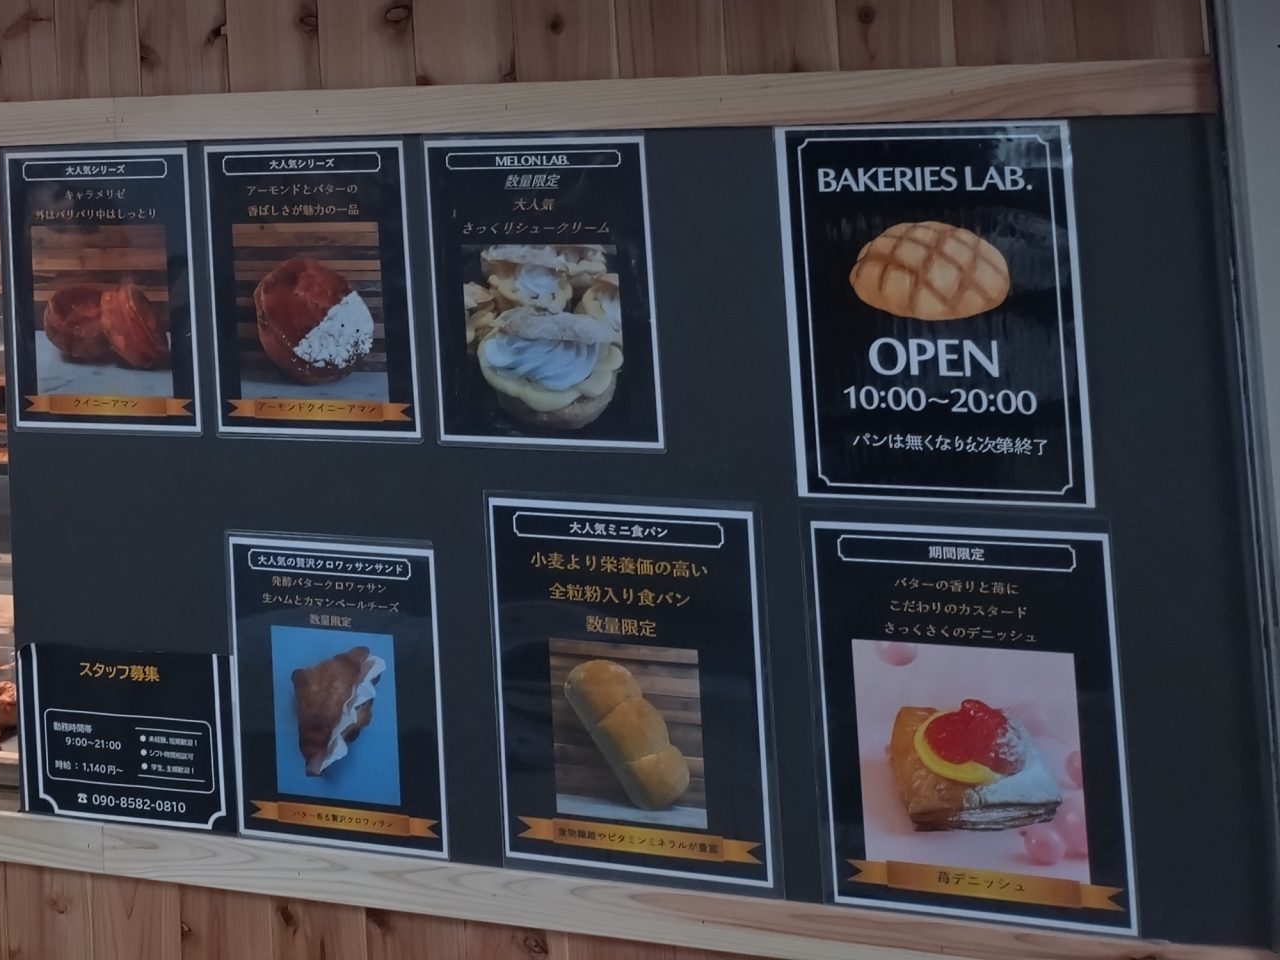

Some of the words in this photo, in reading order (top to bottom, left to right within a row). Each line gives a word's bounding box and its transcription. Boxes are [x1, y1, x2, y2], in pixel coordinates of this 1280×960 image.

[66, 165, 125, 175] 大人気シリーズ
[269, 158, 334, 170] 大人気シリーズ
[505, 174, 560, 188] 数量限定
[818, 166, 958, 192] BAKERIES
[965, 166, 1033, 191] LAB.
[65, 188, 126, 200] キャラメリゼ
[247, 184, 358, 196] アーモンドとバターの
[248, 204, 359, 217] 香ばしさが魅力の一品
[513, 198, 555, 211] 大人気
[869, 337, 999, 378] OPEN
[74, 399, 139, 408] クイニーアマン
[569, 521, 668, 538] 大人気ミニ食パン
[928, 545, 985, 561] 期間限定
[258, 555, 403, 575] 大人気の贅沢クロワッサンサンド
[531, 551, 708, 578] 小麦より栄養価の高い
[272, 576, 387, 593] 発酵バタークロワッサン
[894, 577, 1020, 595] バターの香りと苺に
[262, 592, 400, 613] 生ハムとカマンベールチーズ
[549, 582, 691, 607] 全粒粉入り食パン
[890, 600, 1027, 619] こだわりのカスタード
[310, 614, 352, 628] 数量限定
[586, 615, 657, 637] 数量限定
[79, 662, 160, 682] スタッフ募集
[92, 794, 186, 814] 090-8582-0810
